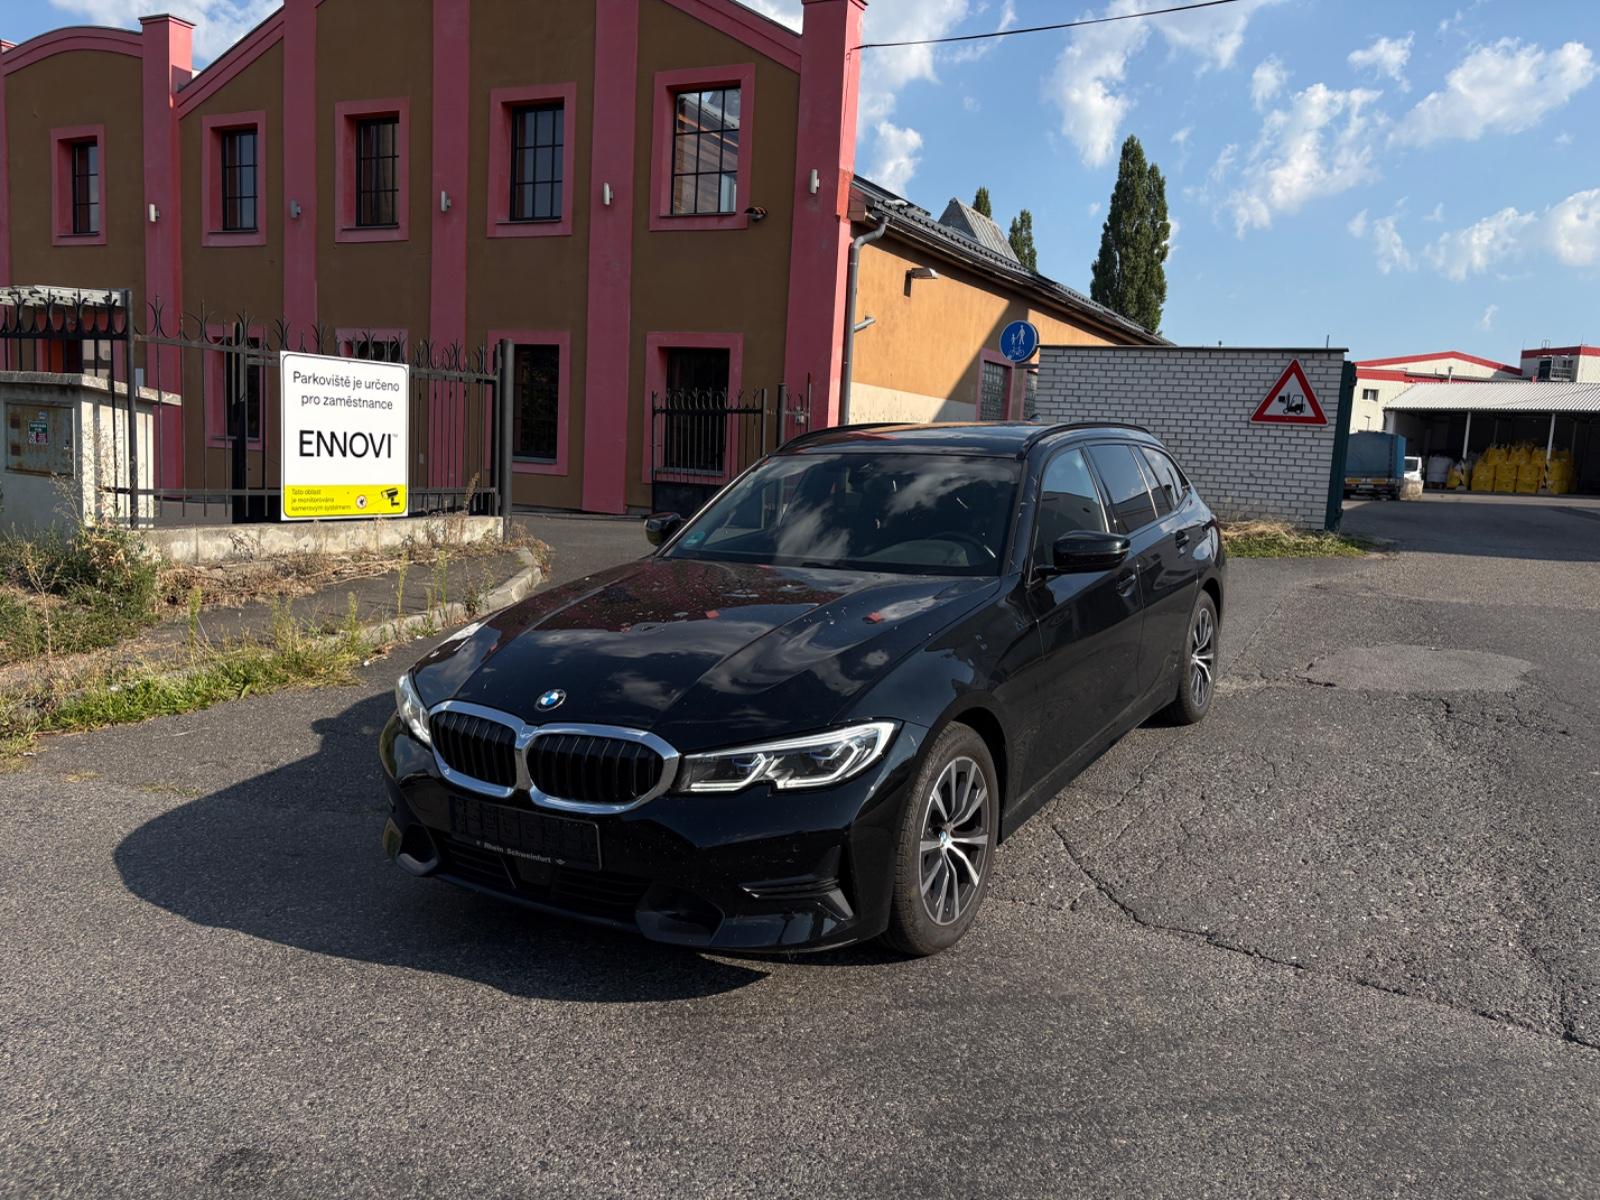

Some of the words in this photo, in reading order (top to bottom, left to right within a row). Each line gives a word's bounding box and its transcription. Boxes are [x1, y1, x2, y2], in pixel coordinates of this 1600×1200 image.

[293, 370, 351, 387] Parkoviště
[352, 377, 362, 390] je
[364, 378, 399, 392] určeno
[301, 394, 321, 406] pro
[323, 395, 393, 410] zaměstnance
[299, 429, 391, 459] ENNOVI
